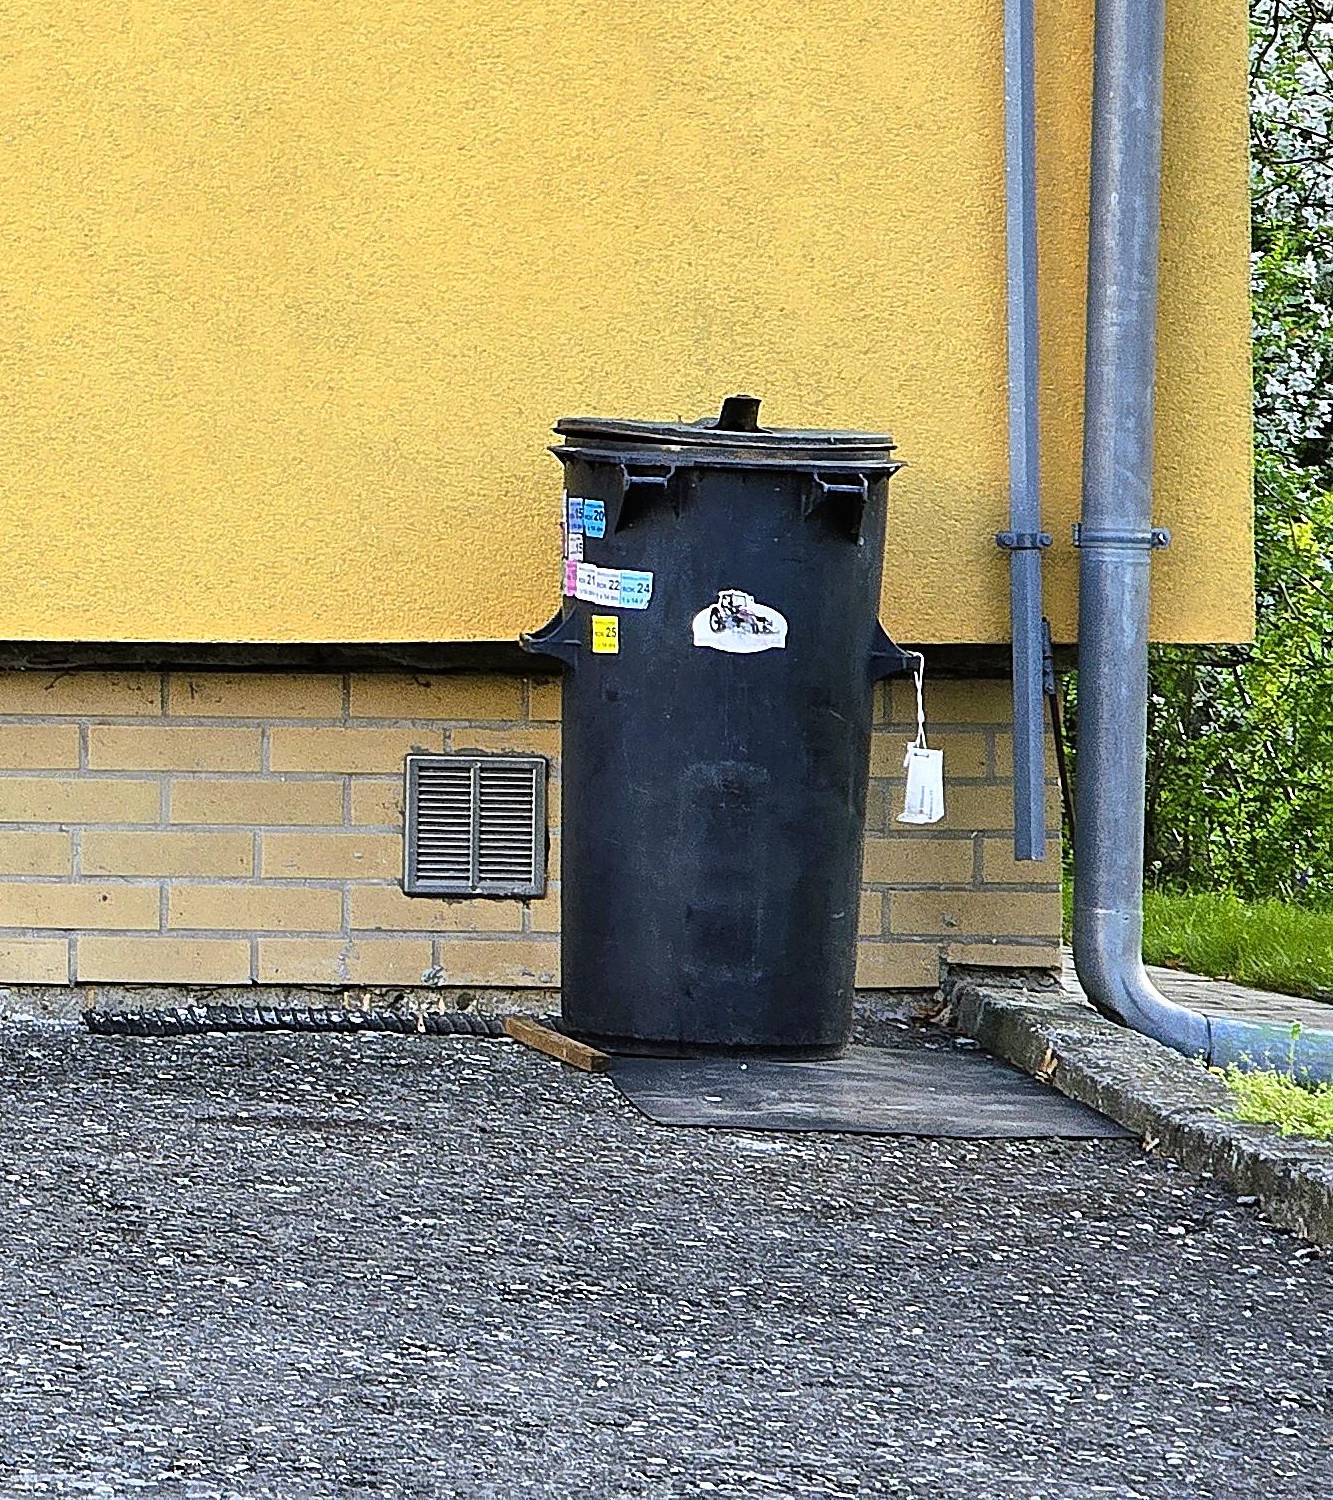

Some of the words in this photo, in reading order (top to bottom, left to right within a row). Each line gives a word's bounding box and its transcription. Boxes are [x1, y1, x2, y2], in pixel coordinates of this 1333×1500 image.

[608, 579, 620, 591] 22
[637, 582, 650, 594] 24
[605, 626, 617, 638] 25
